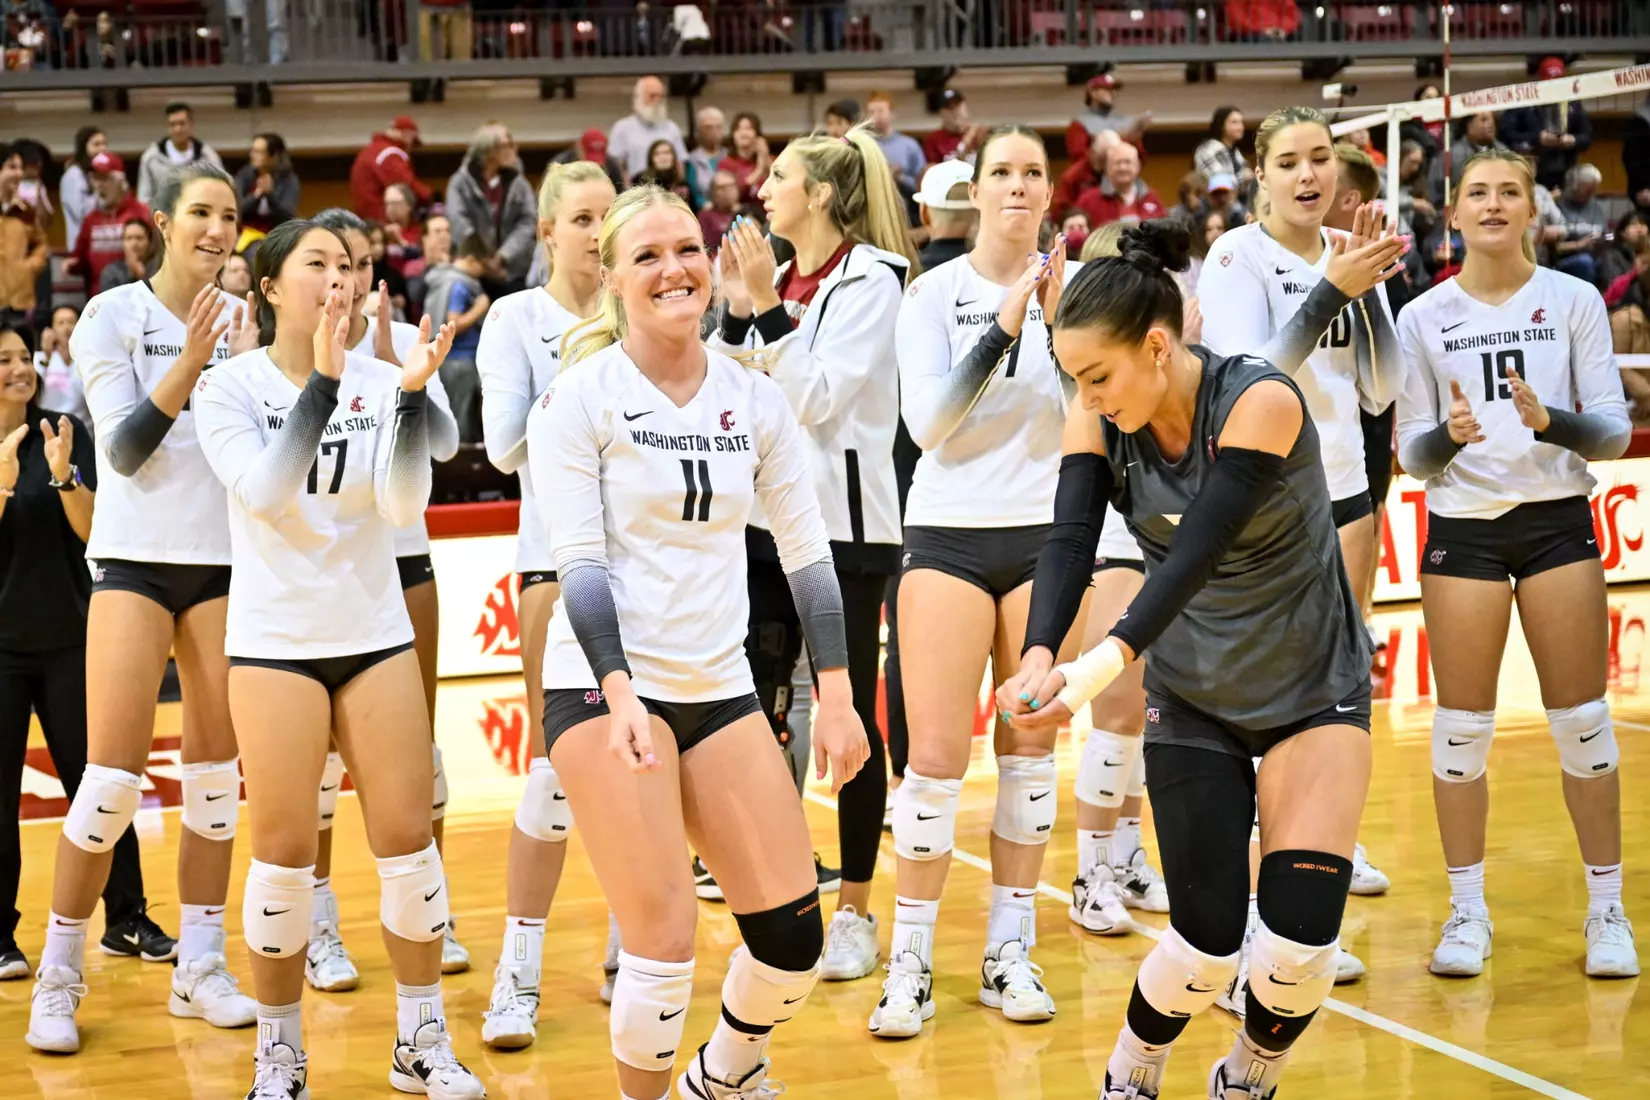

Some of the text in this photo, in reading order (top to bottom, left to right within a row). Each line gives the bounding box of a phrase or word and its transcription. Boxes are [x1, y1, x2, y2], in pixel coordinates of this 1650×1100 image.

[1460, 83, 1539, 108] WASHINGTON STATE
[1443, 328, 1556, 352] WASHINGTON STATE
[1479, 349, 1526, 402] 19
[344, 415, 378, 432] STATE
[629, 429, 750, 453] WASHINGTON STATE
[307, 439, 348, 494] 17
[678, 459, 713, 522] 11
